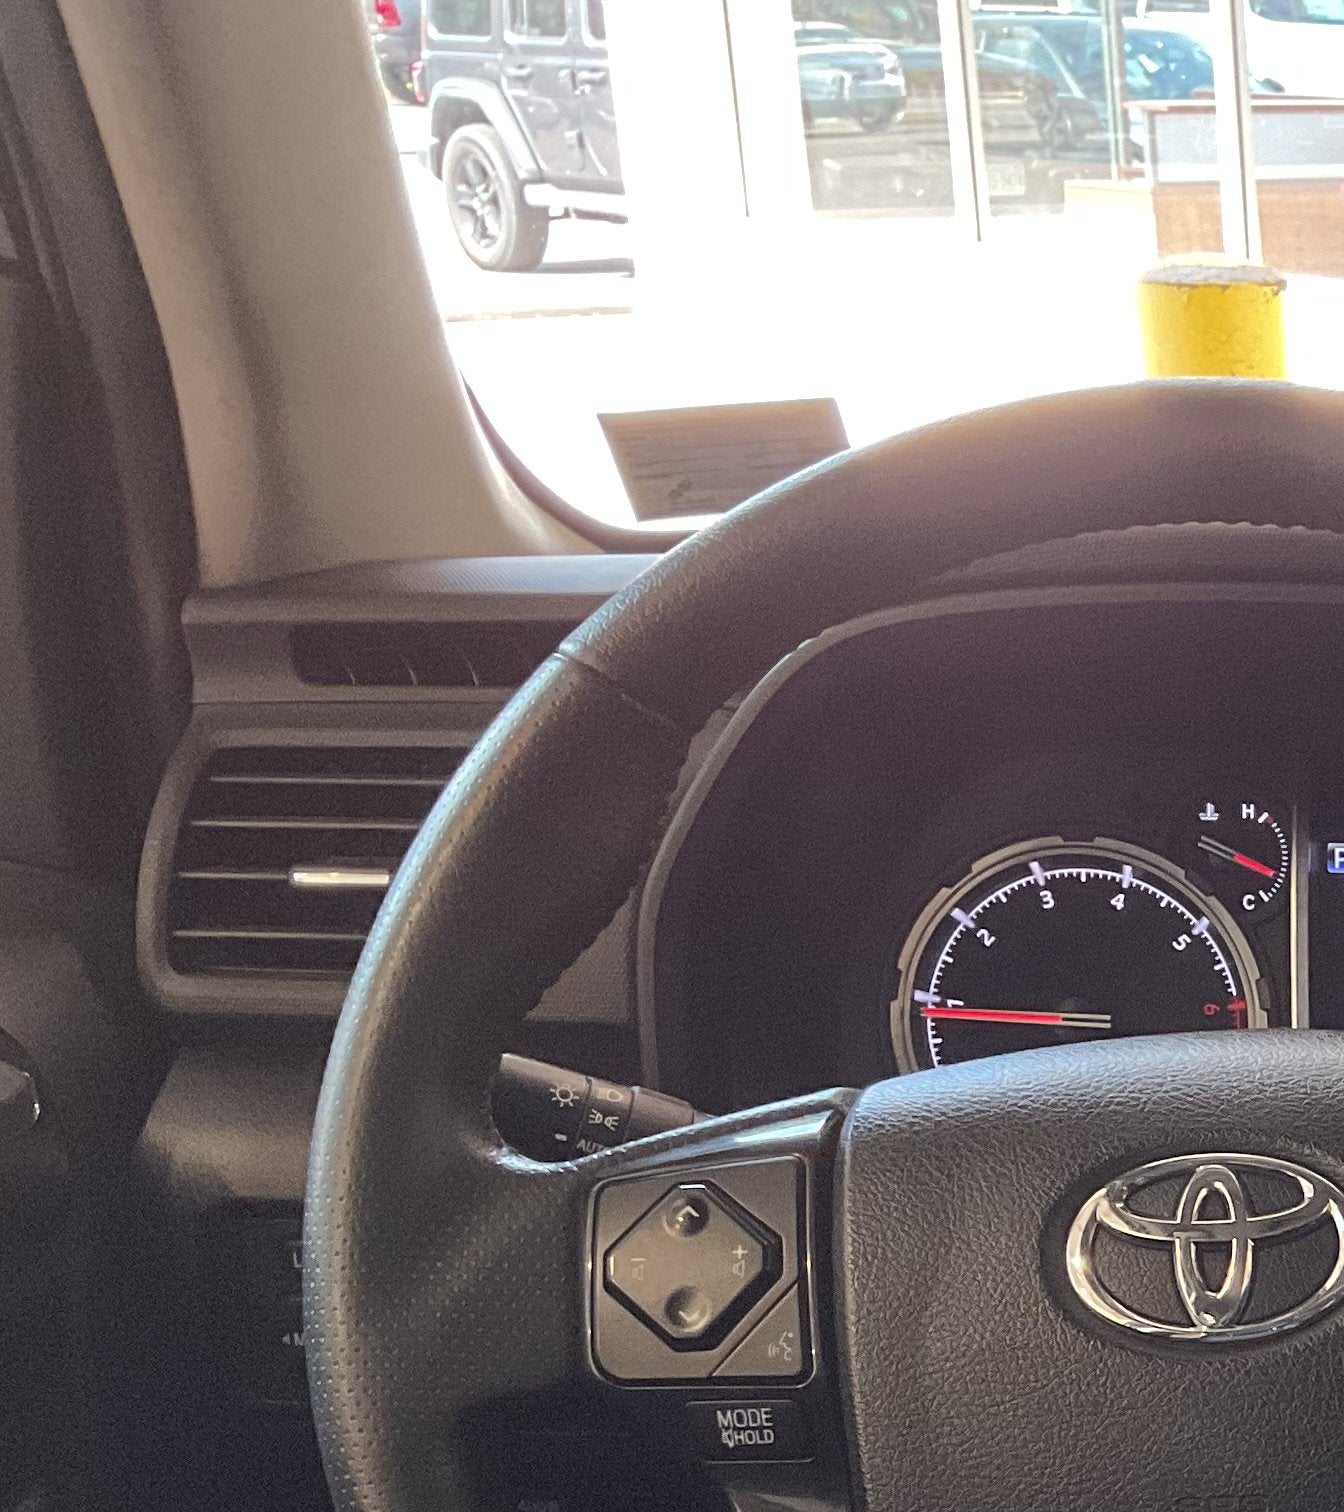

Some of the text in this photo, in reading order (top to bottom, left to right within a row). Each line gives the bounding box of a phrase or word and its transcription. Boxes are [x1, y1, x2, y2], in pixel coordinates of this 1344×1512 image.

[1242, 804, 1255, 819] H
[1040, 890, 1055, 909] 3
[1110, 893, 1125, 911] 4
[1243, 895, 1255, 911] C
[976, 928, 996, 948] 2
[1172, 933, 1191, 952] 5
[1204, 1003, 1220, 1017] 6
[716, 1407, 774, 1430] MODE
[733, 1428, 775, 1446] HOLD
